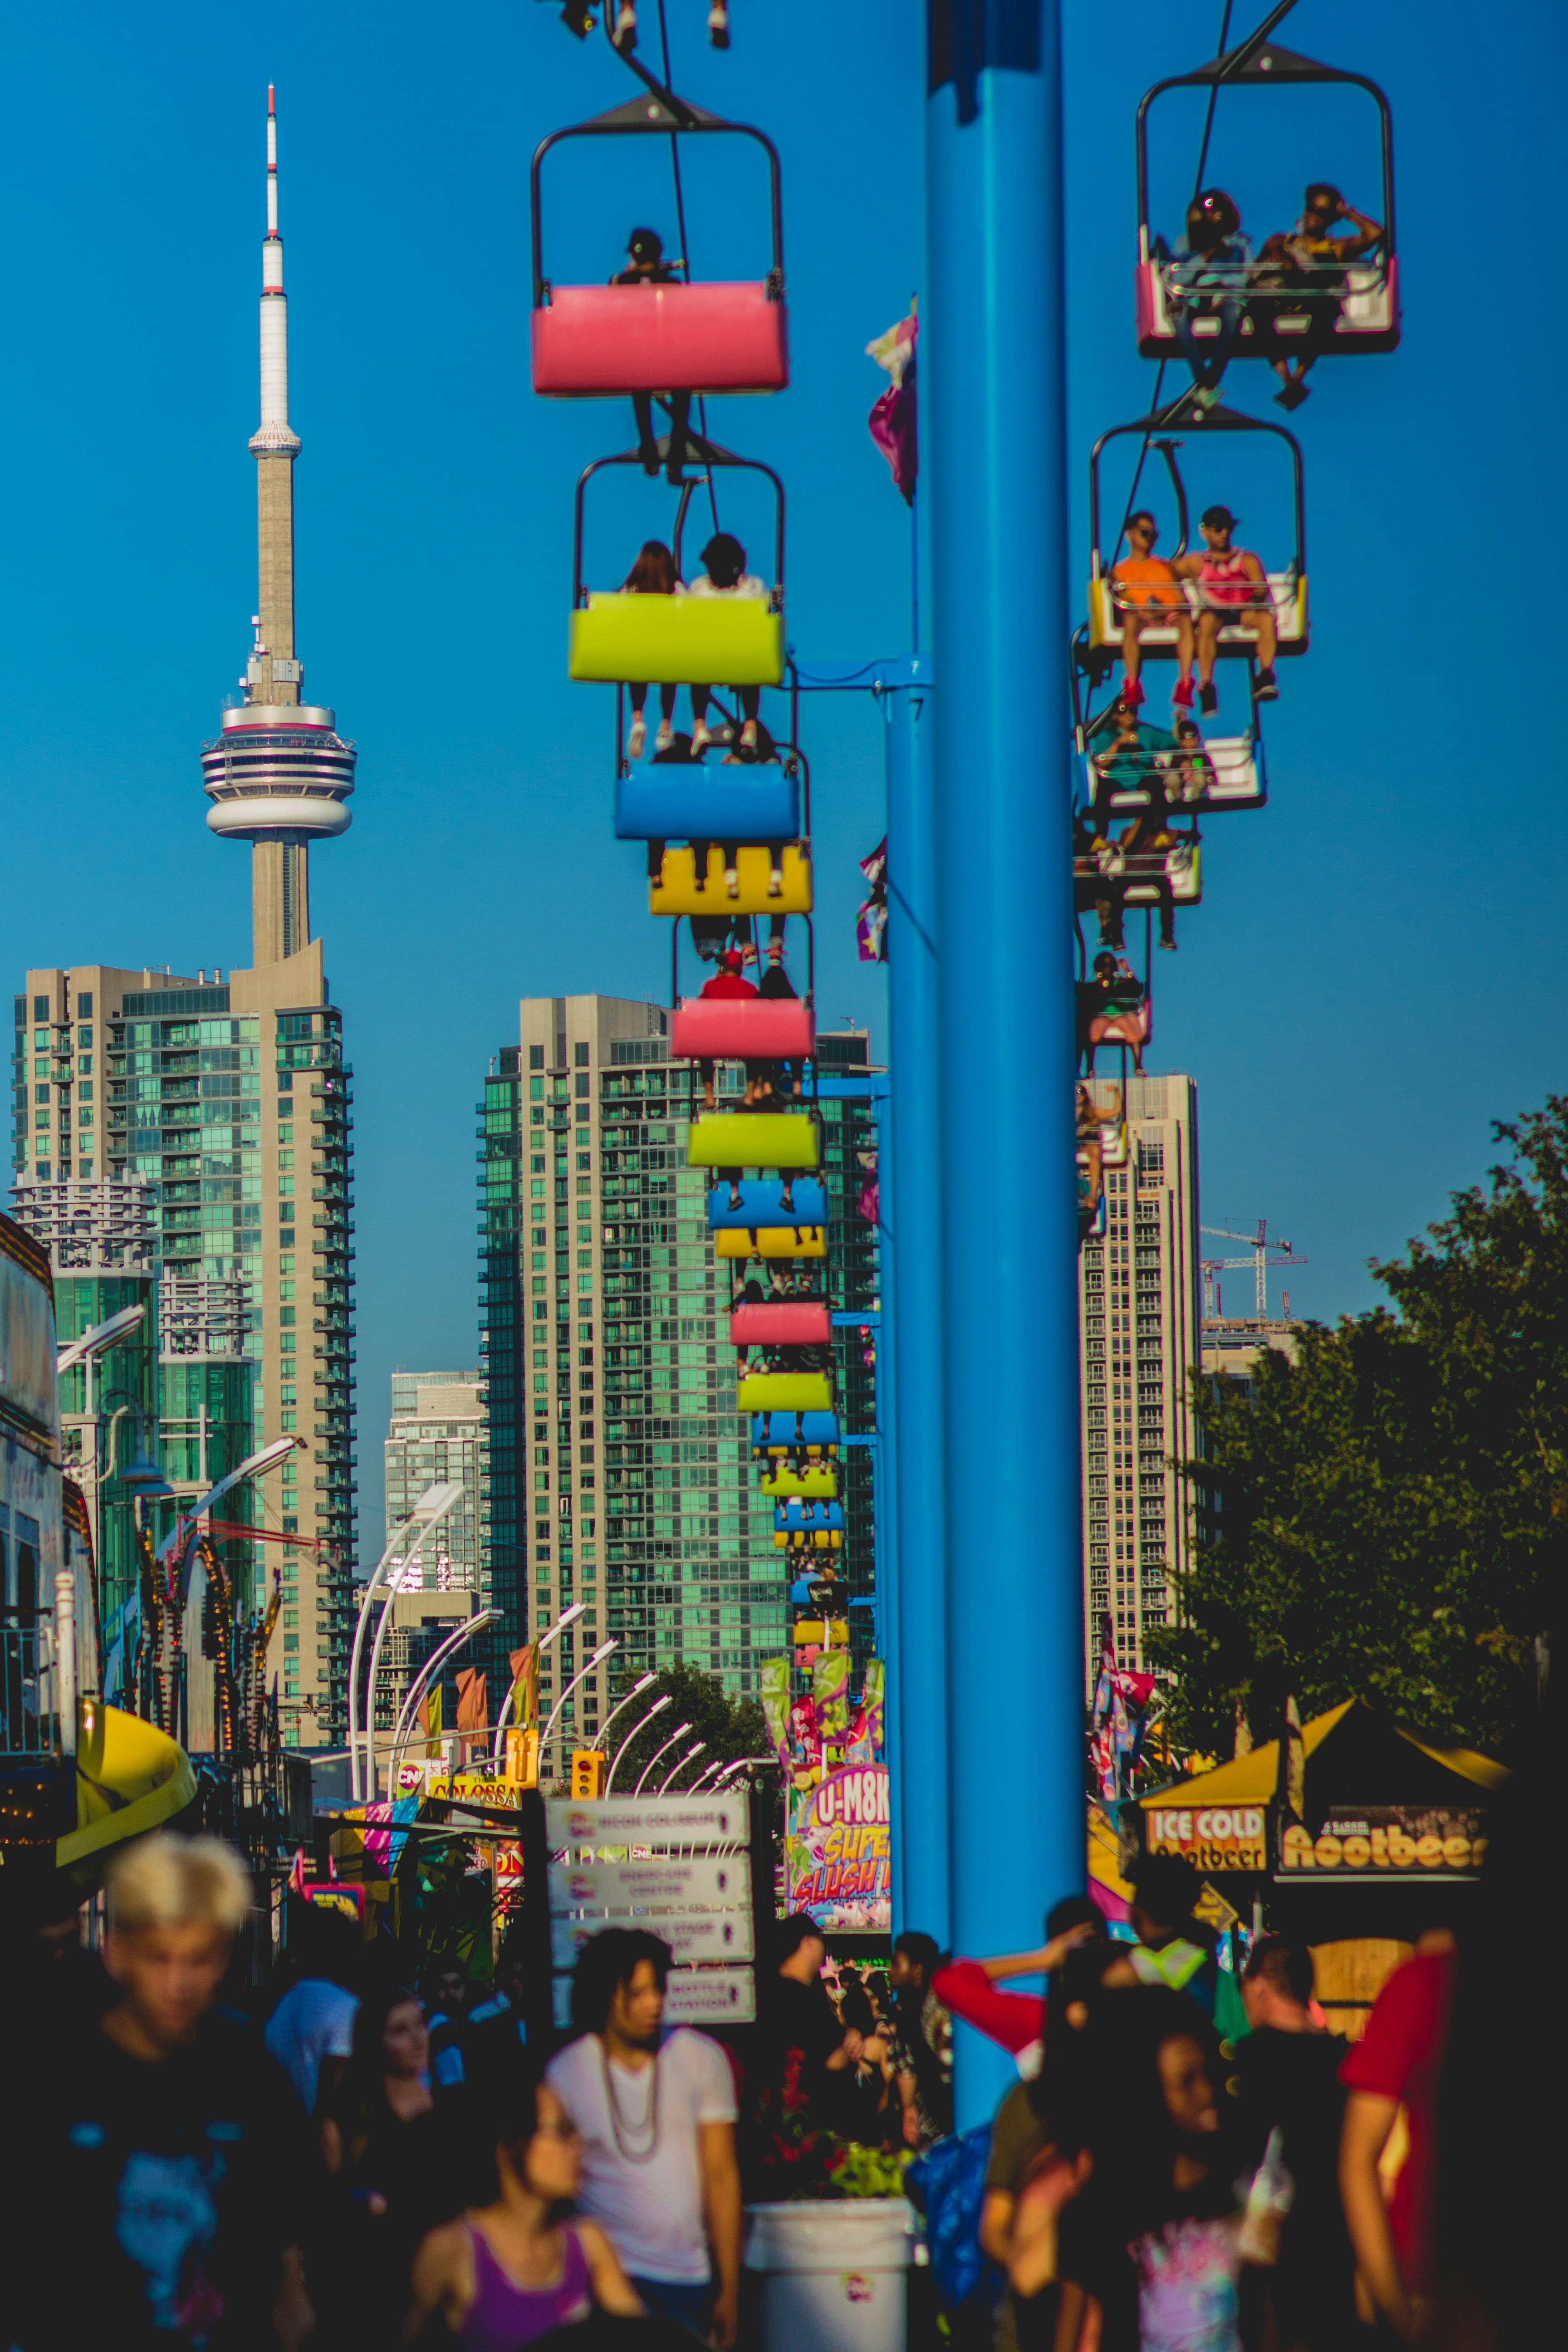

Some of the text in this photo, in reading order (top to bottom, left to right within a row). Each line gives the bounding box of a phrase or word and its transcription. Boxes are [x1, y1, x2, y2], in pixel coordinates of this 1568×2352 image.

[434, 1784, 523, 1810] COLOSSA
[598, 1814, 642, 1829] RICOH
[646, 1810, 715, 1828] COLISEUM
[1155, 1809, 1263, 1841] ICE COLD
[632, 1849, 651, 1859] CNE
[824, 1827, 891, 1867] SUPE
[1284, 1825, 1490, 1867] Rootbeer
[669, 1998, 729, 2013] STATION
